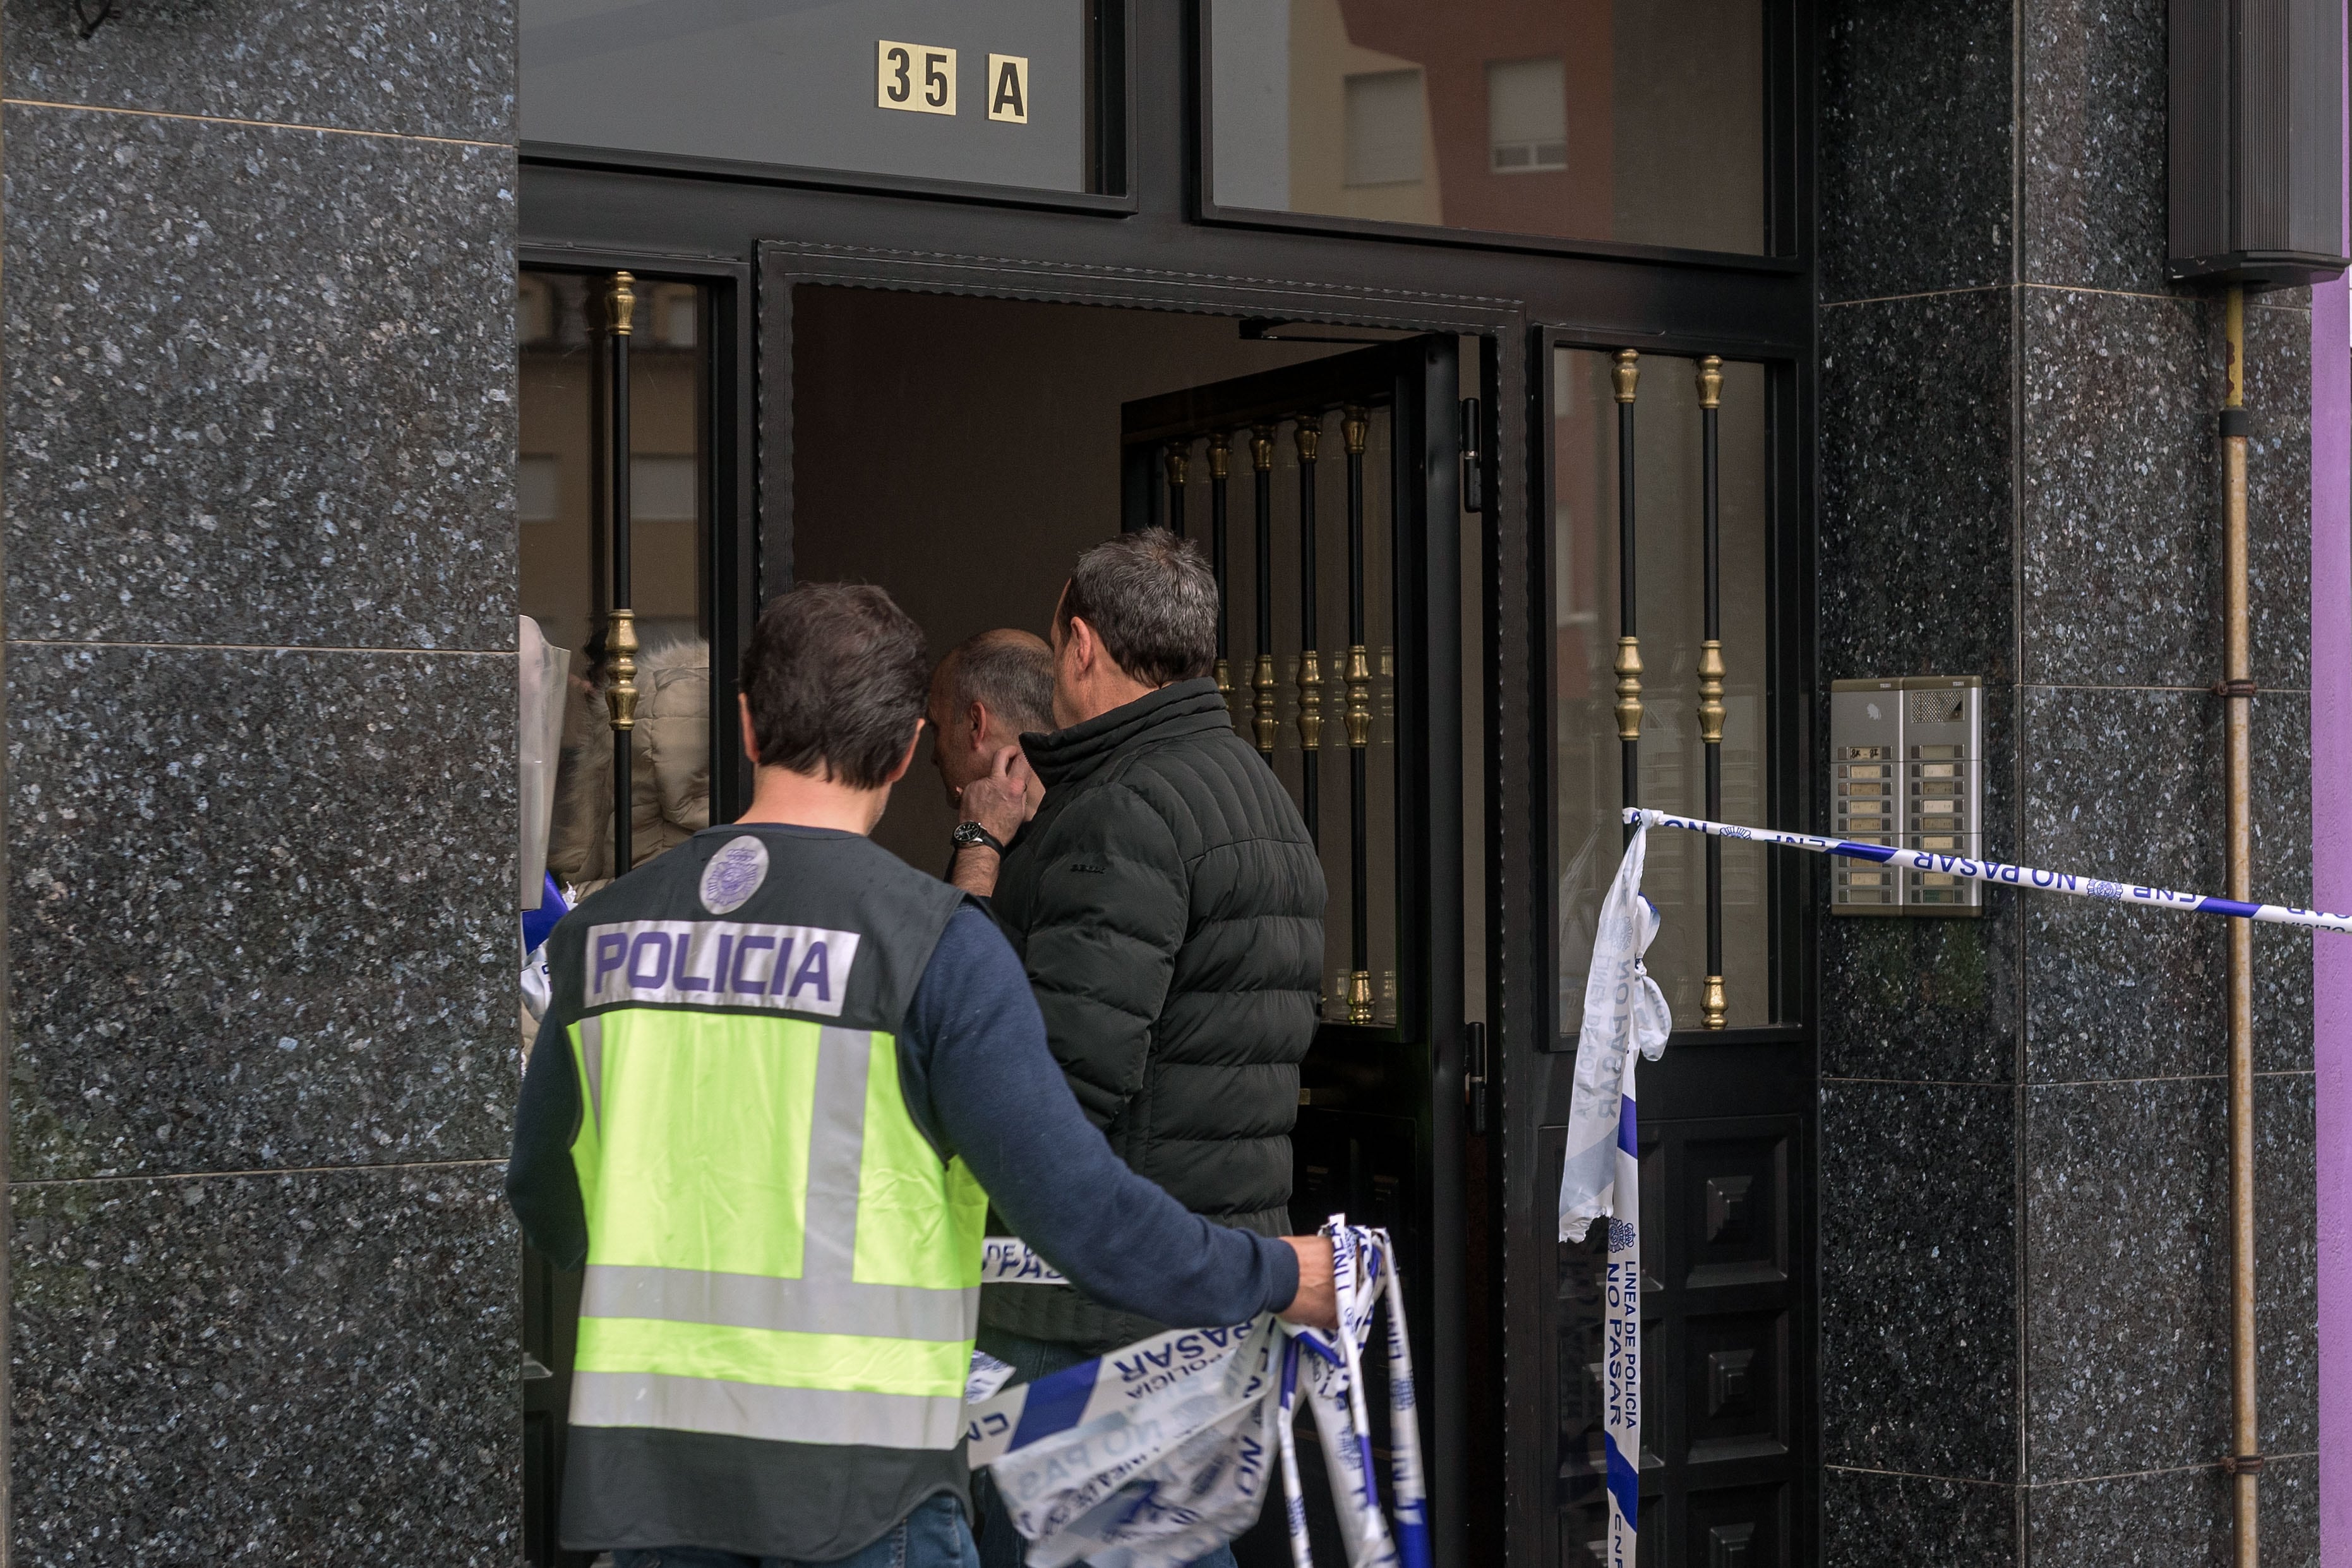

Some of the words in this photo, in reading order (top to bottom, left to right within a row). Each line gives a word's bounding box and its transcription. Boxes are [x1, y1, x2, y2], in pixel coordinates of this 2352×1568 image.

[886, 47, 948, 107] 35
[992, 61, 1024, 117] A
[1913, 851, 2020, 883] PASAR
[2031, 868, 2077, 890] NO
[593, 931, 831, 1002] POLICIA
[1607, 1262, 1621, 1308] NO
[1624, 1261, 1637, 1317] LINEA
[1624, 1322, 1636, 1348] DE
[1609, 1318, 1623, 1426] PASAR
[1624, 1353, 1637, 1430] POLICIA
